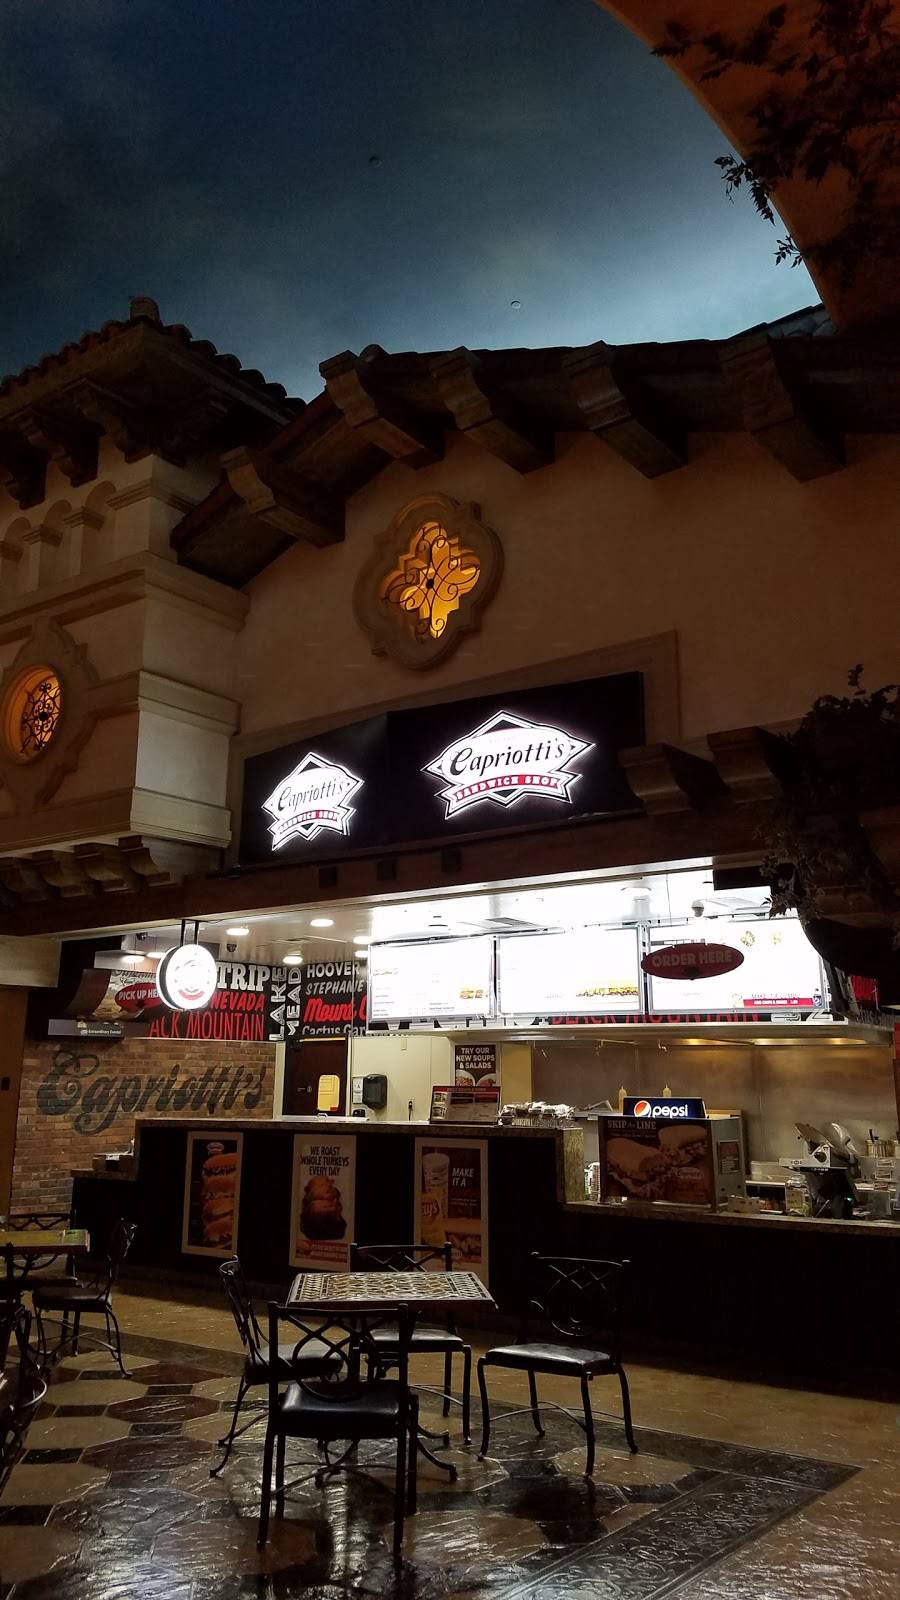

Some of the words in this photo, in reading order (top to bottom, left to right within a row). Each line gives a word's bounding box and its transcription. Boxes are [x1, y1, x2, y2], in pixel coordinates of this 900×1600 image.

[450, 738, 565, 776] Capriotti's
[278, 777, 344, 812] Capriotti's
[455, 776, 520, 800] SANDWICH
[524, 775, 560, 788] SHOP
[652, 953, 697, 967] ORDER
[699, 950, 732, 963] HERE
[307, 961, 361, 978] HOOVER
[118, 990, 136, 1000] PICK
[136, 989, 147, 999] UP
[305, 979, 365, 995] STEPHANIE
[209, 992, 266, 1011] NEVADA
[269, 967, 287, 1041] LAKE
[286, 967, 302, 1036] MEAD
[303, 998, 357, 1023] Mount
[186, 1011, 265, 1041] MOUNTAIN
[302, 1024, 341, 1036] Cactus
[652, 1104, 689, 1118] pepsi
[607, 1120, 627, 1129] SKIP
[636, 1121, 657, 1130] LINE
[310, 1146, 321, 1155] WE
[321, 1146, 341, 1155] ROAST
[301, 1156, 321, 1166] WHOLE
[322, 1156, 350, 1167] TURKEYS
[309, 1166, 328, 1176] EVERY
[328, 1166, 341, 1176] DAY
[452, 1167, 474, 1178] MAKE
[452, 1178, 459, 1187] IT
[460, 1179, 467, 1188] A
